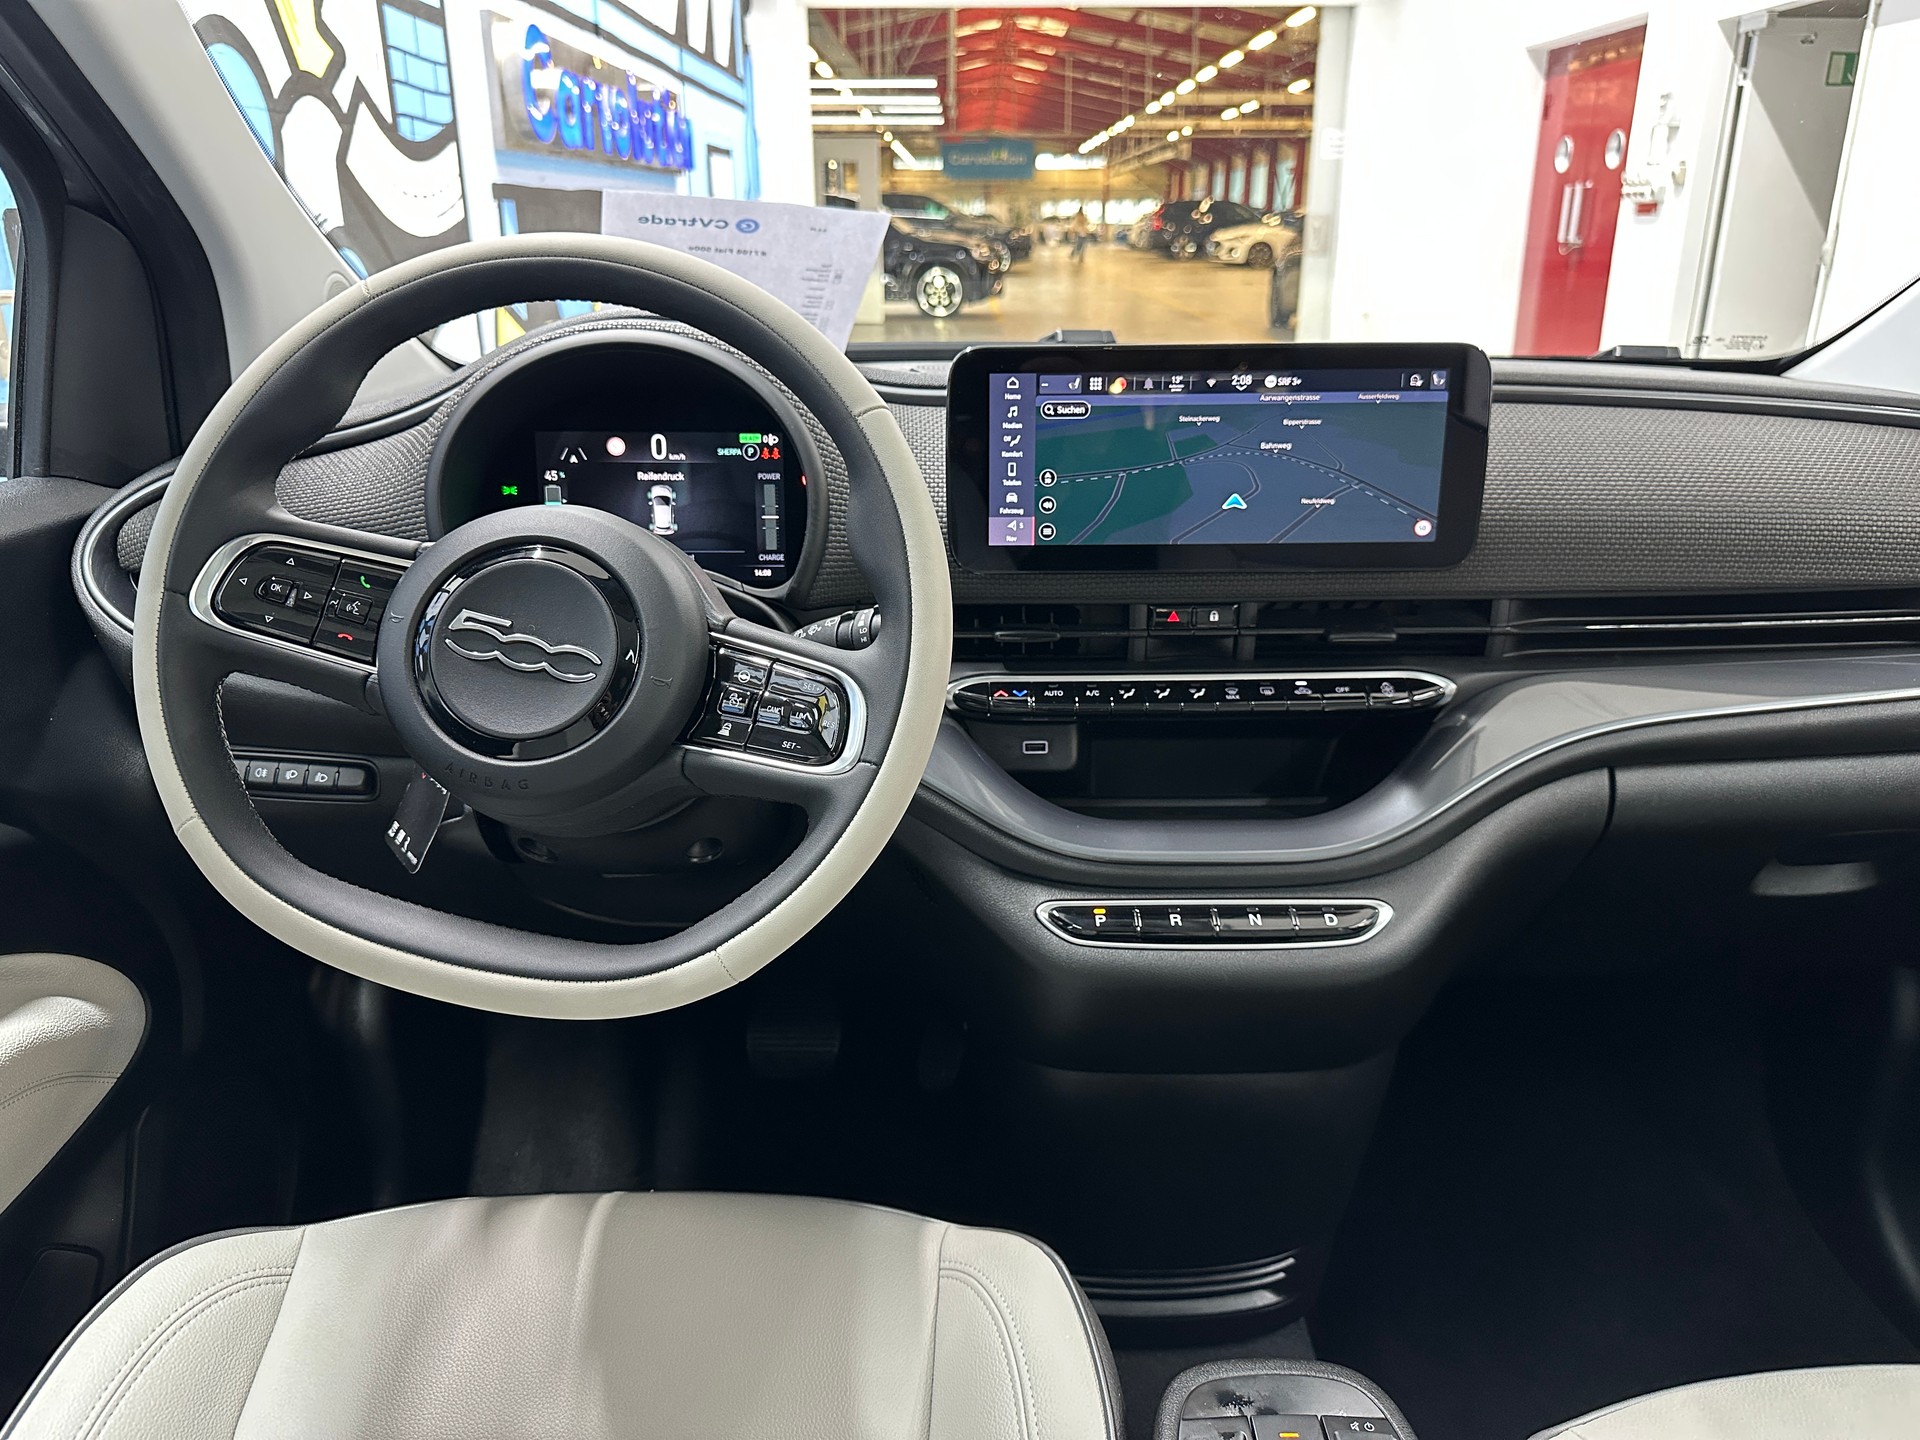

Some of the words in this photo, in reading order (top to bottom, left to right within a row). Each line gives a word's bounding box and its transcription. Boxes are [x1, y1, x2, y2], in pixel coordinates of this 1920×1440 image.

[1231, 374, 1253, 386] 2:08
[1259, 394, 1321, 402] Aarwangenstrasse
[1358, 393, 1400, 401] Ausserfeldweg
[1057, 406, 1086, 415] Suchen
[1178, 415, 1221, 423] Steinackerweg
[650, 433, 667, 460] 0
[716, 447, 742, 456] SHERPA
[1260, 442, 1292, 451] Bahnweg
[668, 453, 686, 461] km/h
[747, 447, 755, 457] P
[1001, 450, 1024, 458] Komfort
[543, 470, 559, 481] 45
[636, 471, 685, 481] Reifendruck
[757, 472, 781, 480] POWER
[999, 507, 1025, 516] Fahrzeug
[758, 553, 785, 562] CHARGE
[270, 582, 283, 593] OK
[823, 719, 836, 729] RES
[444, 762, 530, 790] AIRBAG
[1094, 914, 1107, 927] P
[1169, 913, 1183, 926] R
[1248, 913, 1263, 926] N
[1324, 913, 1338, 926] D
